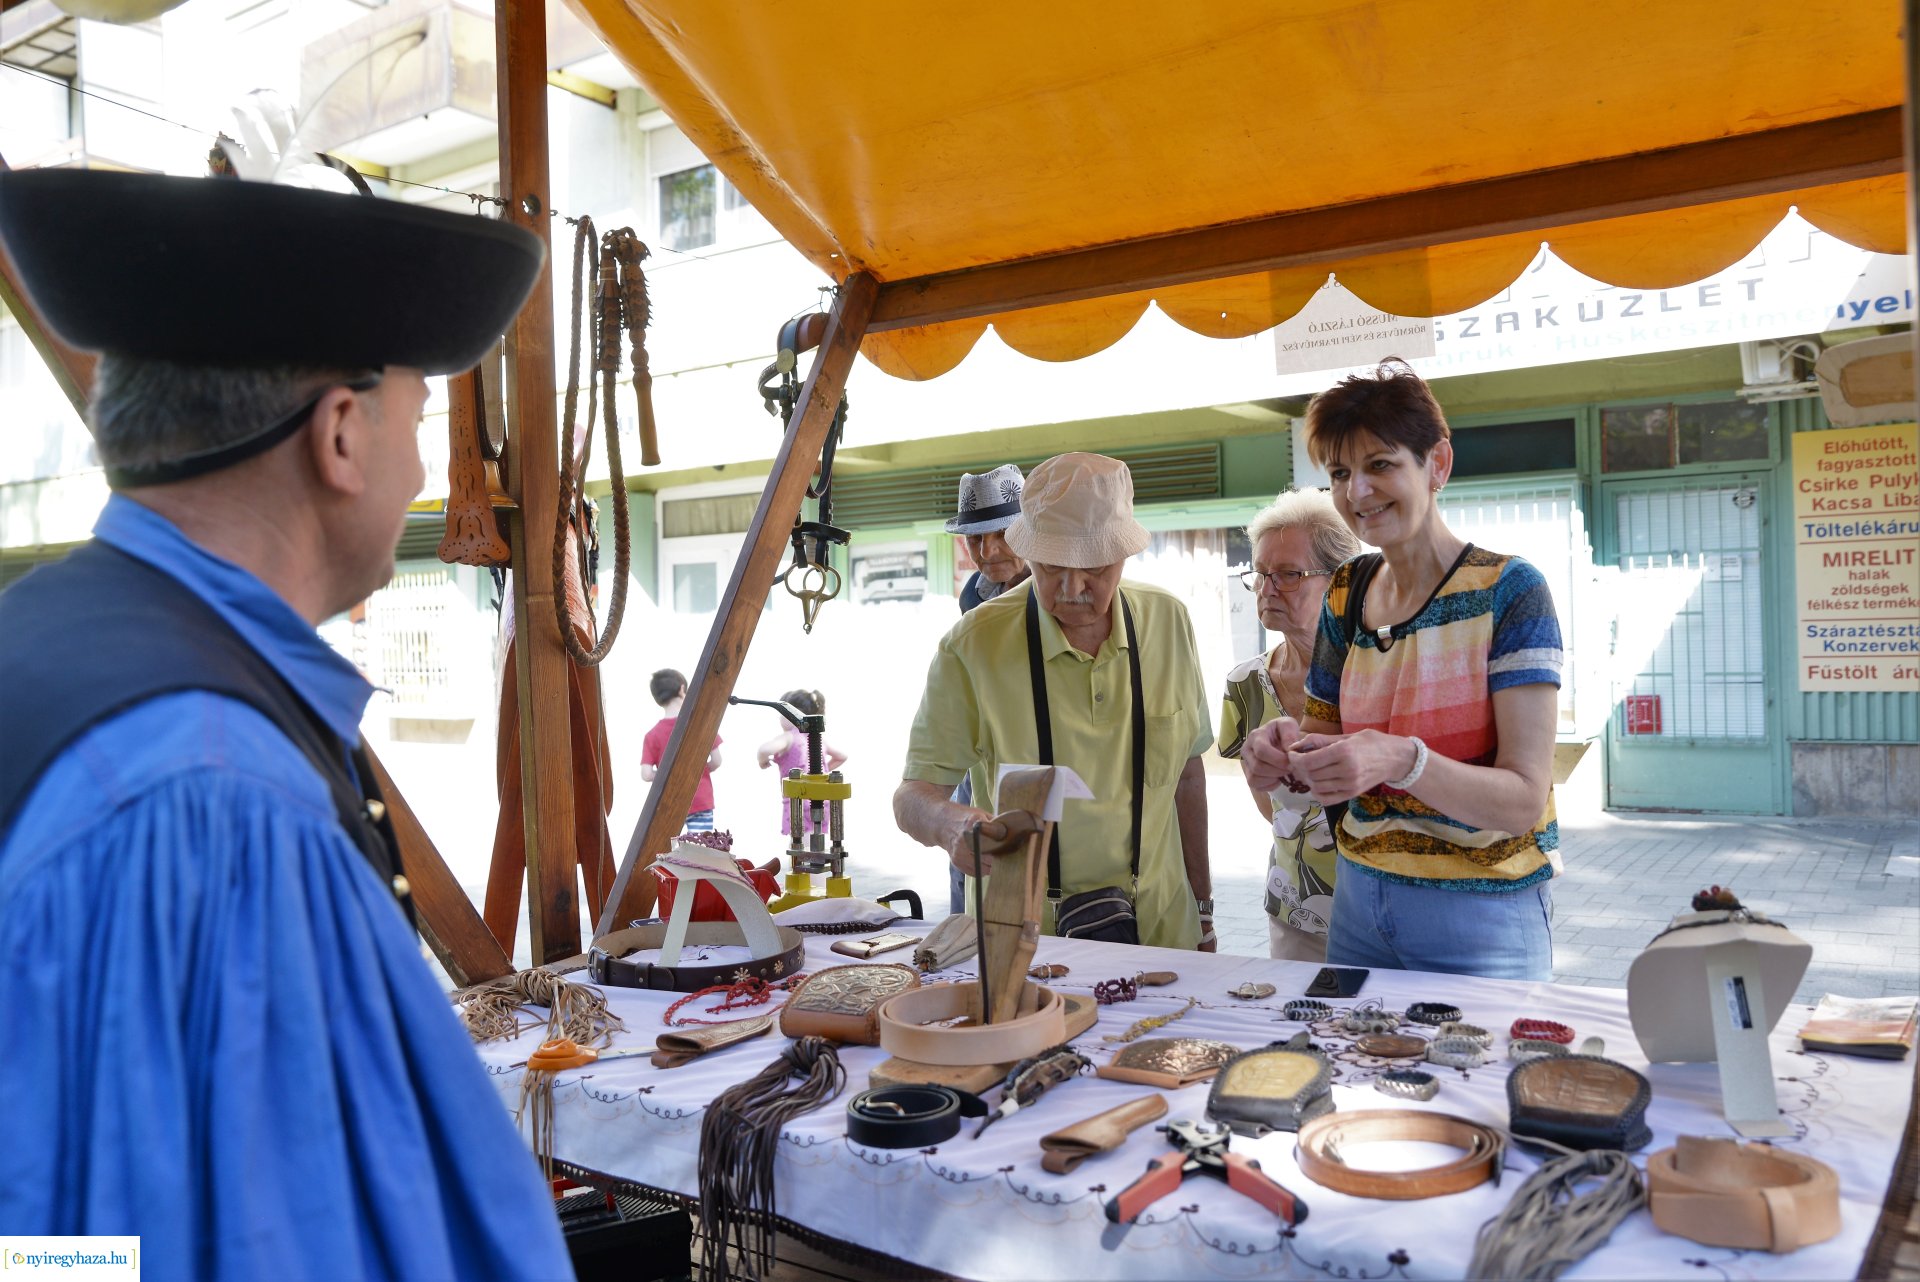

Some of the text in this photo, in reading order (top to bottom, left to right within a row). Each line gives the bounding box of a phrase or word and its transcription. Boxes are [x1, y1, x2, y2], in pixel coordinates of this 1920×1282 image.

[1817, 453, 1917, 473] fagyasztott
[1799, 477, 1858, 493] Csirke
[1812, 497, 1873, 511] Kacsa
[1804, 519, 1919, 538] Töltelékáru
[1823, 548, 1916, 568] MIRELIT
[1848, 569, 1891, 581] halak
[1831, 582, 1910, 597] zöldségek
[1807, 598, 1860, 611] félkész
[1823, 639, 1920, 652] Konzervek
